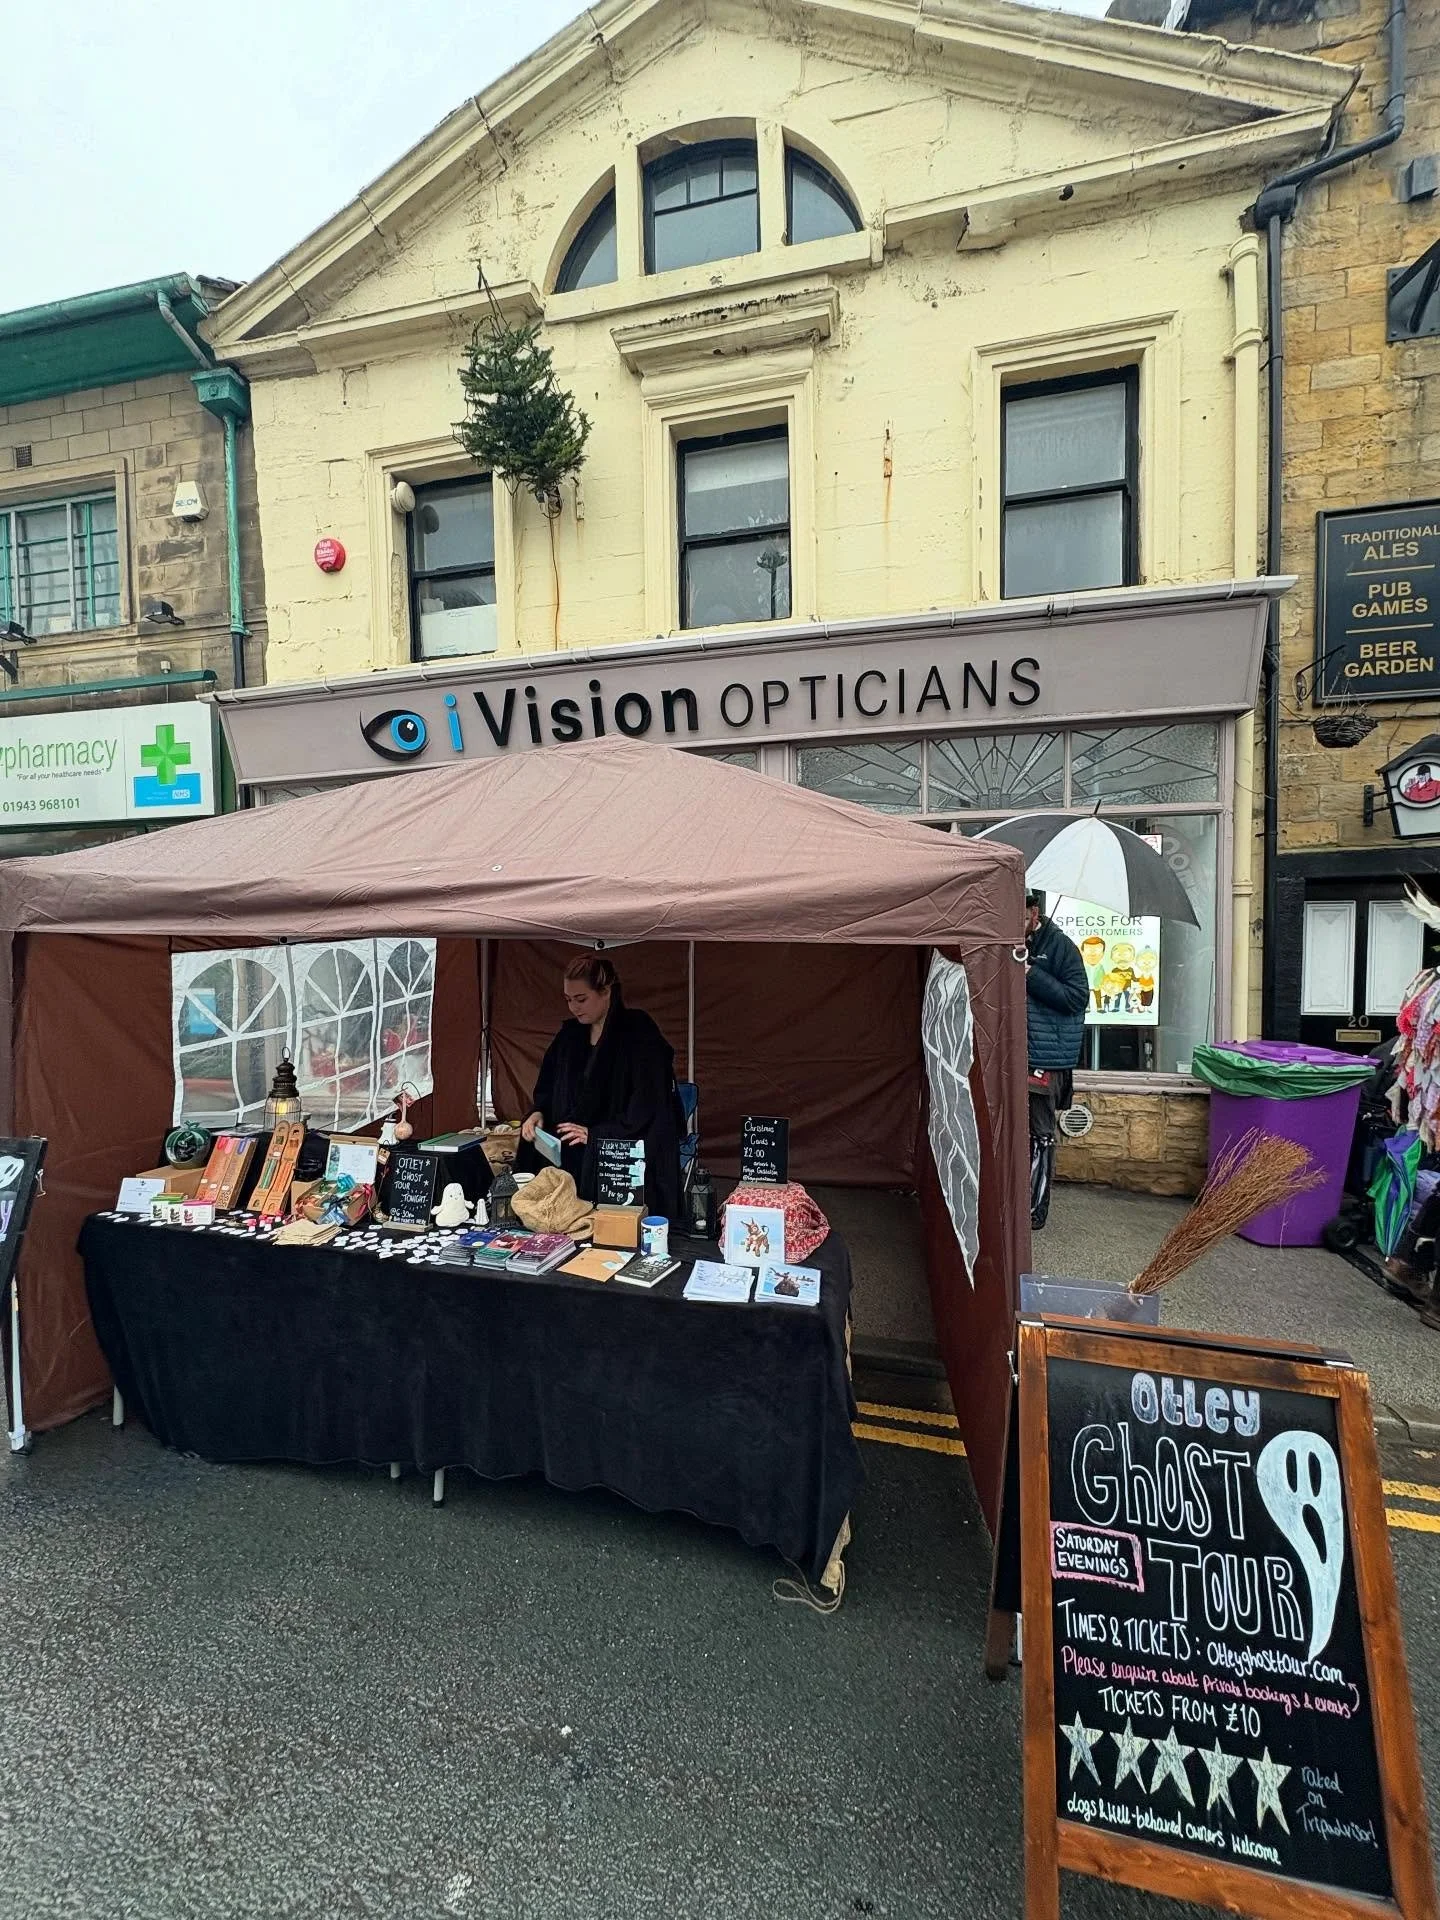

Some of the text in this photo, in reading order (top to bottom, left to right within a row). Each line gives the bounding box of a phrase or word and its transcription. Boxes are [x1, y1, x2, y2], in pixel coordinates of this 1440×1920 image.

[1342, 525, 1440, 545] TRADITIONAL
[1363, 541, 1420, 561] ALES
[1368, 581, 1412, 599] PUB
[1352, 598, 1428, 618] GAMES
[1360, 640, 1418, 659] BEER
[1344, 657, 1434, 678] GARDEN
[719, 657, 1042, 727] OPTICIANS
[0, 738, 117, 778] pharmacy
[52, 770, 82, 778] healthcare
[173, 790, 190, 798] NHS
[3, 798, 80, 812] 01943 968101
[1056, 915, 1142, 927] SPECS FOR
[1078, 928, 1143, 937] CUSTOMERS
[1348, 1015, 1369, 1027] 20
[745, 1120, 775, 1133] Christmas
[750, 1133, 768, 1145] Cards
[398, 1157, 424, 1171] OTLEY
[394, 1180, 411, 1190] TOUR
[401, 1170, 424, 1182] GHOST
[402, 1193, 427, 1203] TONIGHT
[1055, 1528, 1119, 1554] SATURDAY
[1057, 1550, 1129, 1579] EVENINGS
[1147, 1537, 1304, 1642] TOUR
[1061, 1646, 1106, 1677] Please
[1111, 1664, 1160, 1687] enquire
[1162, 1668, 1200, 1688] about
[1246, 1686, 1300, 1717] bookings
[1315, 1697, 1352, 1719] events
[1098, 1686, 1262, 1738] TICKETS FROM £10
[1301, 1765, 1344, 1794] rated
[1307, 1791, 1327, 1810] on
[1067, 1791, 1097, 1822] dogs
[1185, 1822, 1226, 1848] owners
